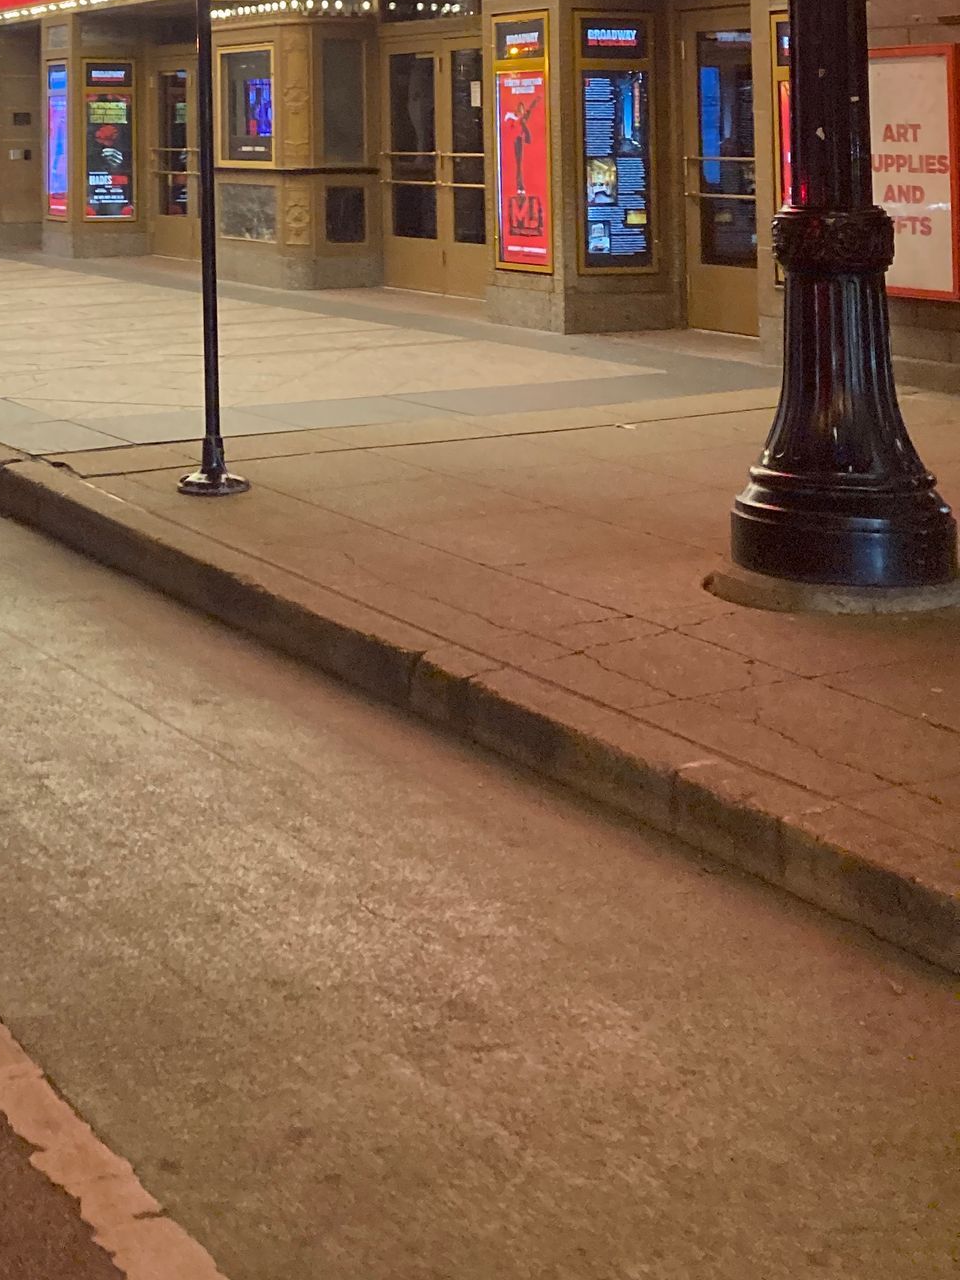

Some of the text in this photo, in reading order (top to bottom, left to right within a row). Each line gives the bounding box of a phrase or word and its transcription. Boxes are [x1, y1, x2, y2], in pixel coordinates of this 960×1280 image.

[587, 28, 637, 40] BROADWAY
[882, 123, 922, 143] ART
[872, 153, 950, 174] UPPLIES
[882, 184, 926, 204] AND
[895, 215, 933, 236] FTS
